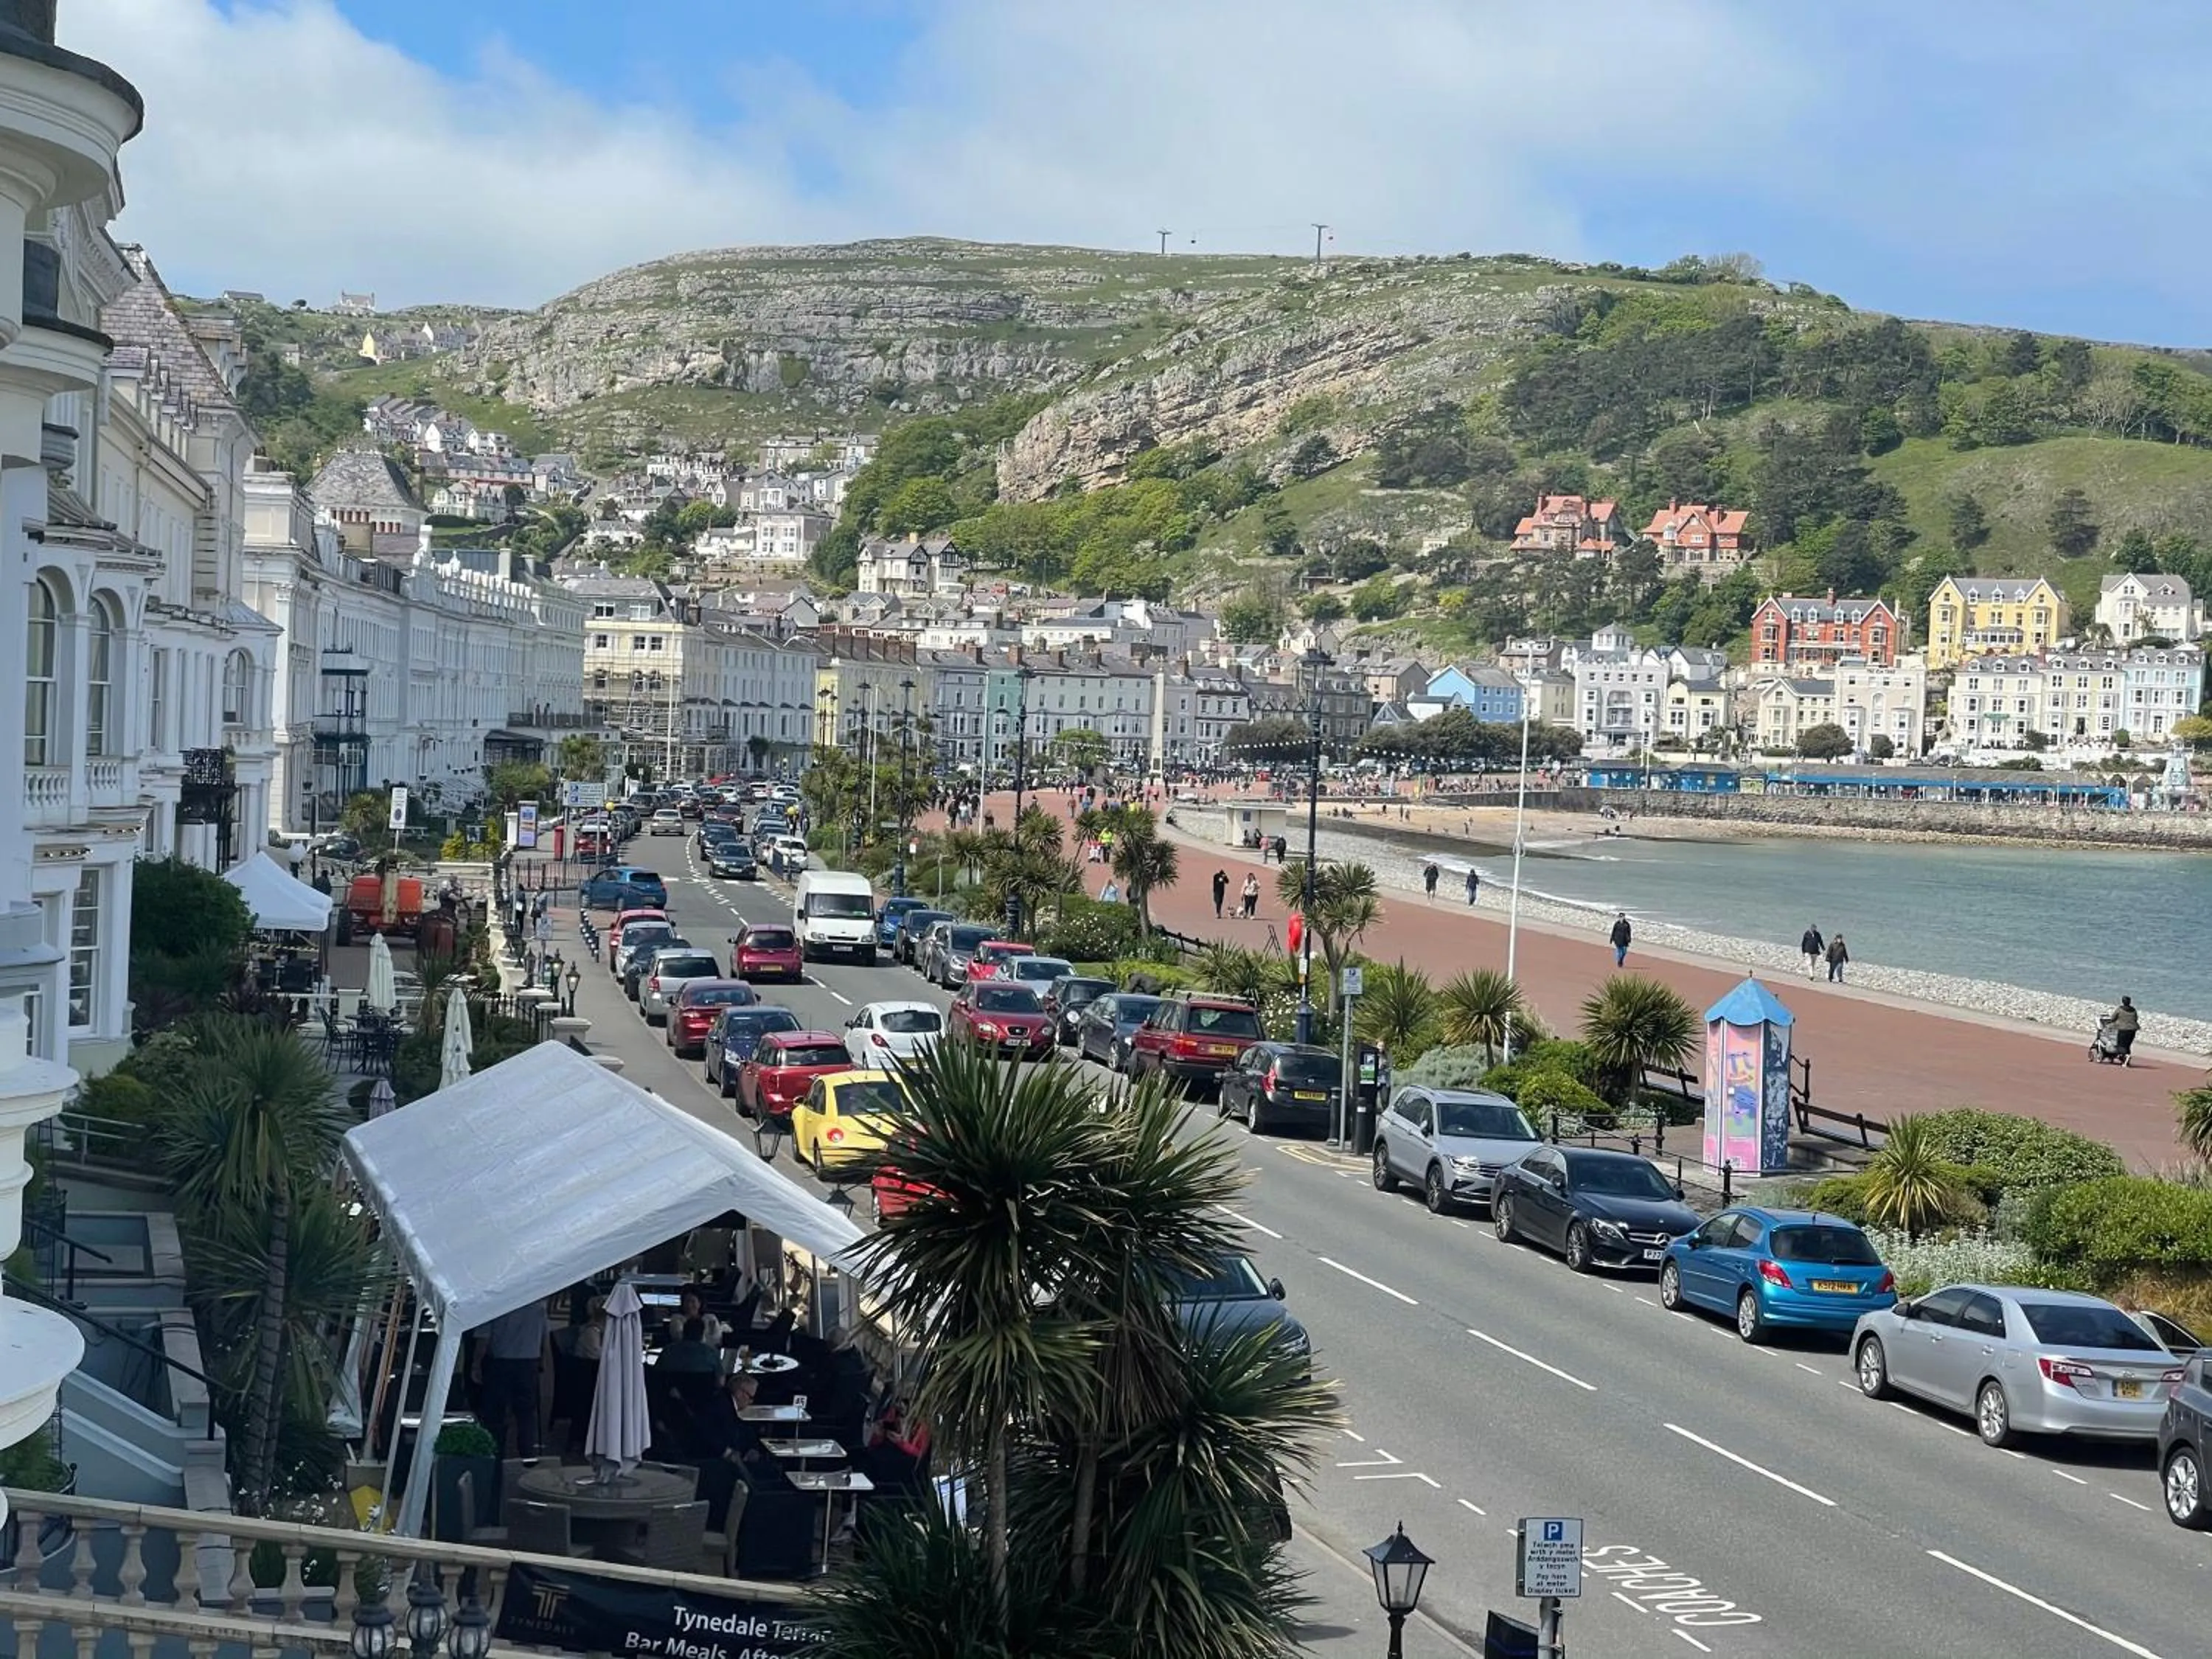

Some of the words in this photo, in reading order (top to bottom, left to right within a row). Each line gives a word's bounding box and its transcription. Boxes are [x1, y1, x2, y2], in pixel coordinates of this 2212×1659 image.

[1548, 1523, 1559, 1539] P
[1582, 1545, 1762, 1626] COACHES
[673, 1606, 768, 1638] Tynedale
[625, 1632, 661, 1652] Bar
